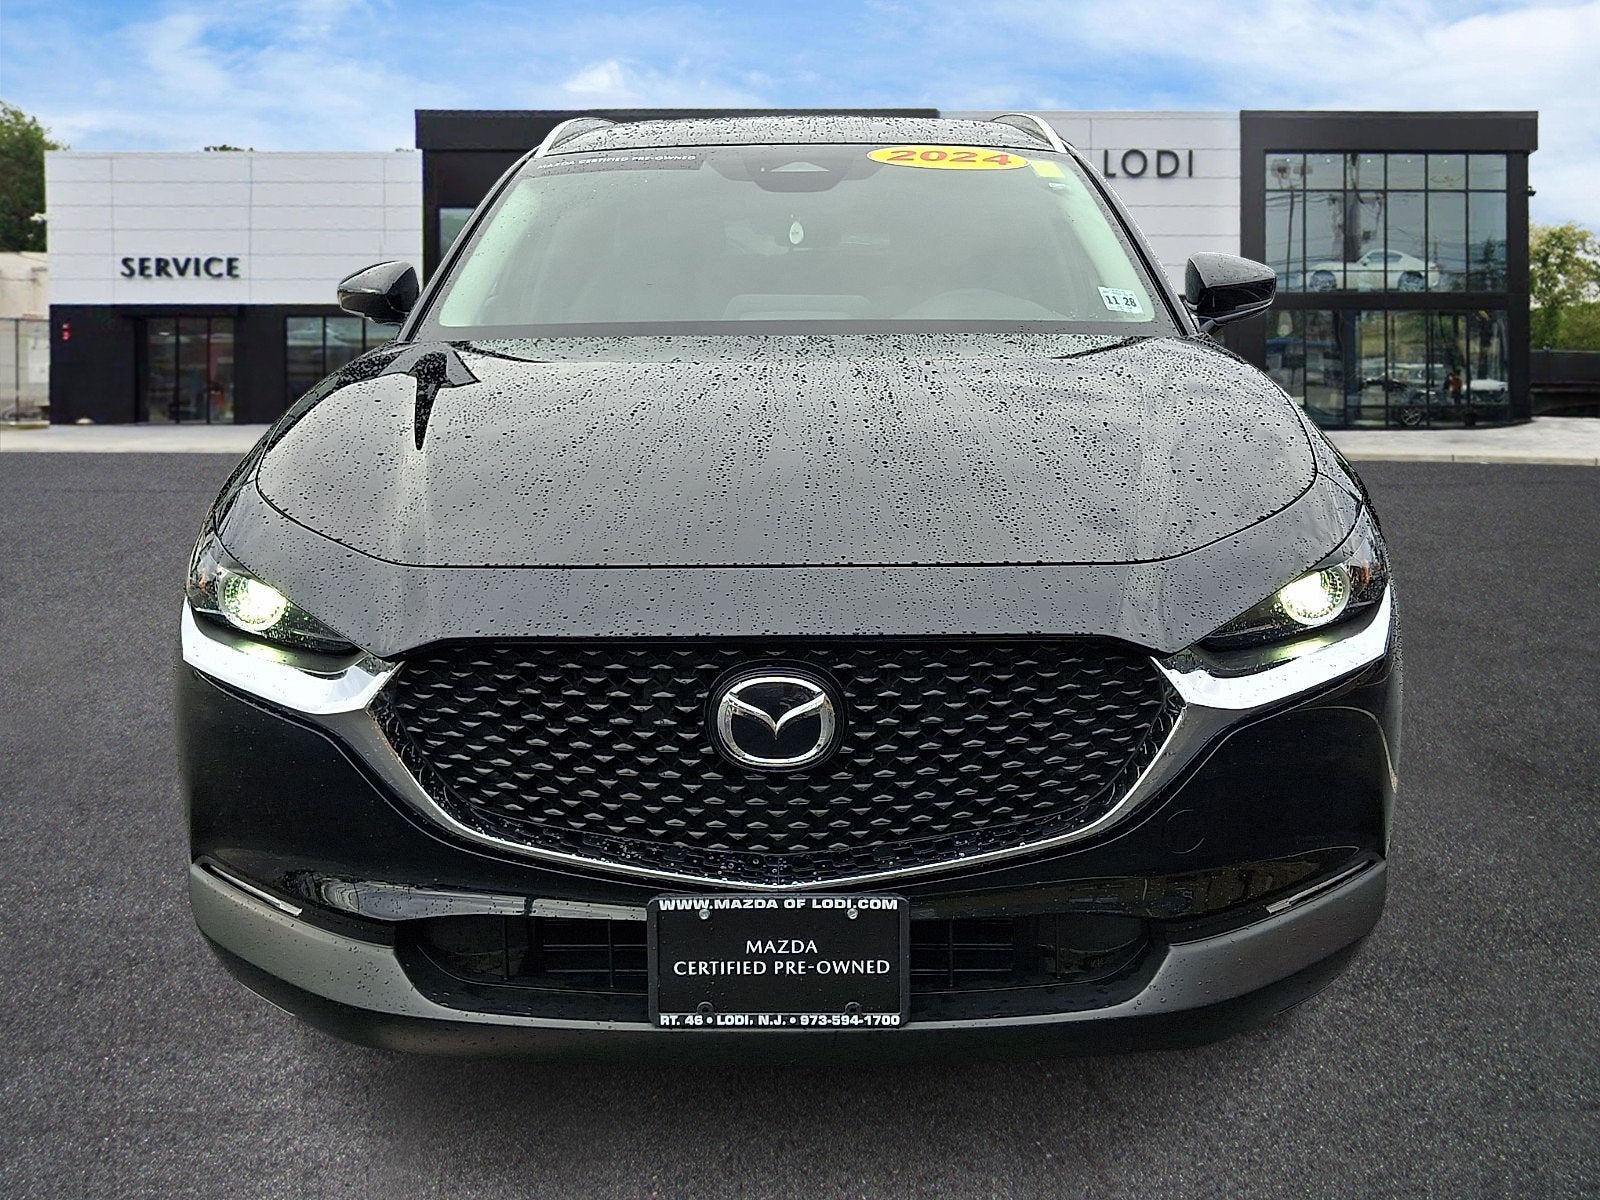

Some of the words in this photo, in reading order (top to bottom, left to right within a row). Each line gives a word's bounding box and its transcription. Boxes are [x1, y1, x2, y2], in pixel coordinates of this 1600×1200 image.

[886, 150, 1012, 166] 2024
[1104, 149, 1194, 179] LODI
[120, 256, 240, 279] SERVICE
[1105, 295, 1120, 305] 11
[658, 899, 779, 911] WWW.MAZDA
[783, 899, 806, 910] OF
[811, 899, 898, 910] LODI.COM
[745, 940, 818, 954] MAZDA
[673, 960, 767, 975] CERTIFIED
[774, 960, 890, 974] PRE-OWNED
[660, 1014, 681, 1026] RT.
[684, 1014, 703, 1026] 46
[758, 1014, 786, 1026] N.J.
[800, 1014, 900, 1026] 973-594-1700
